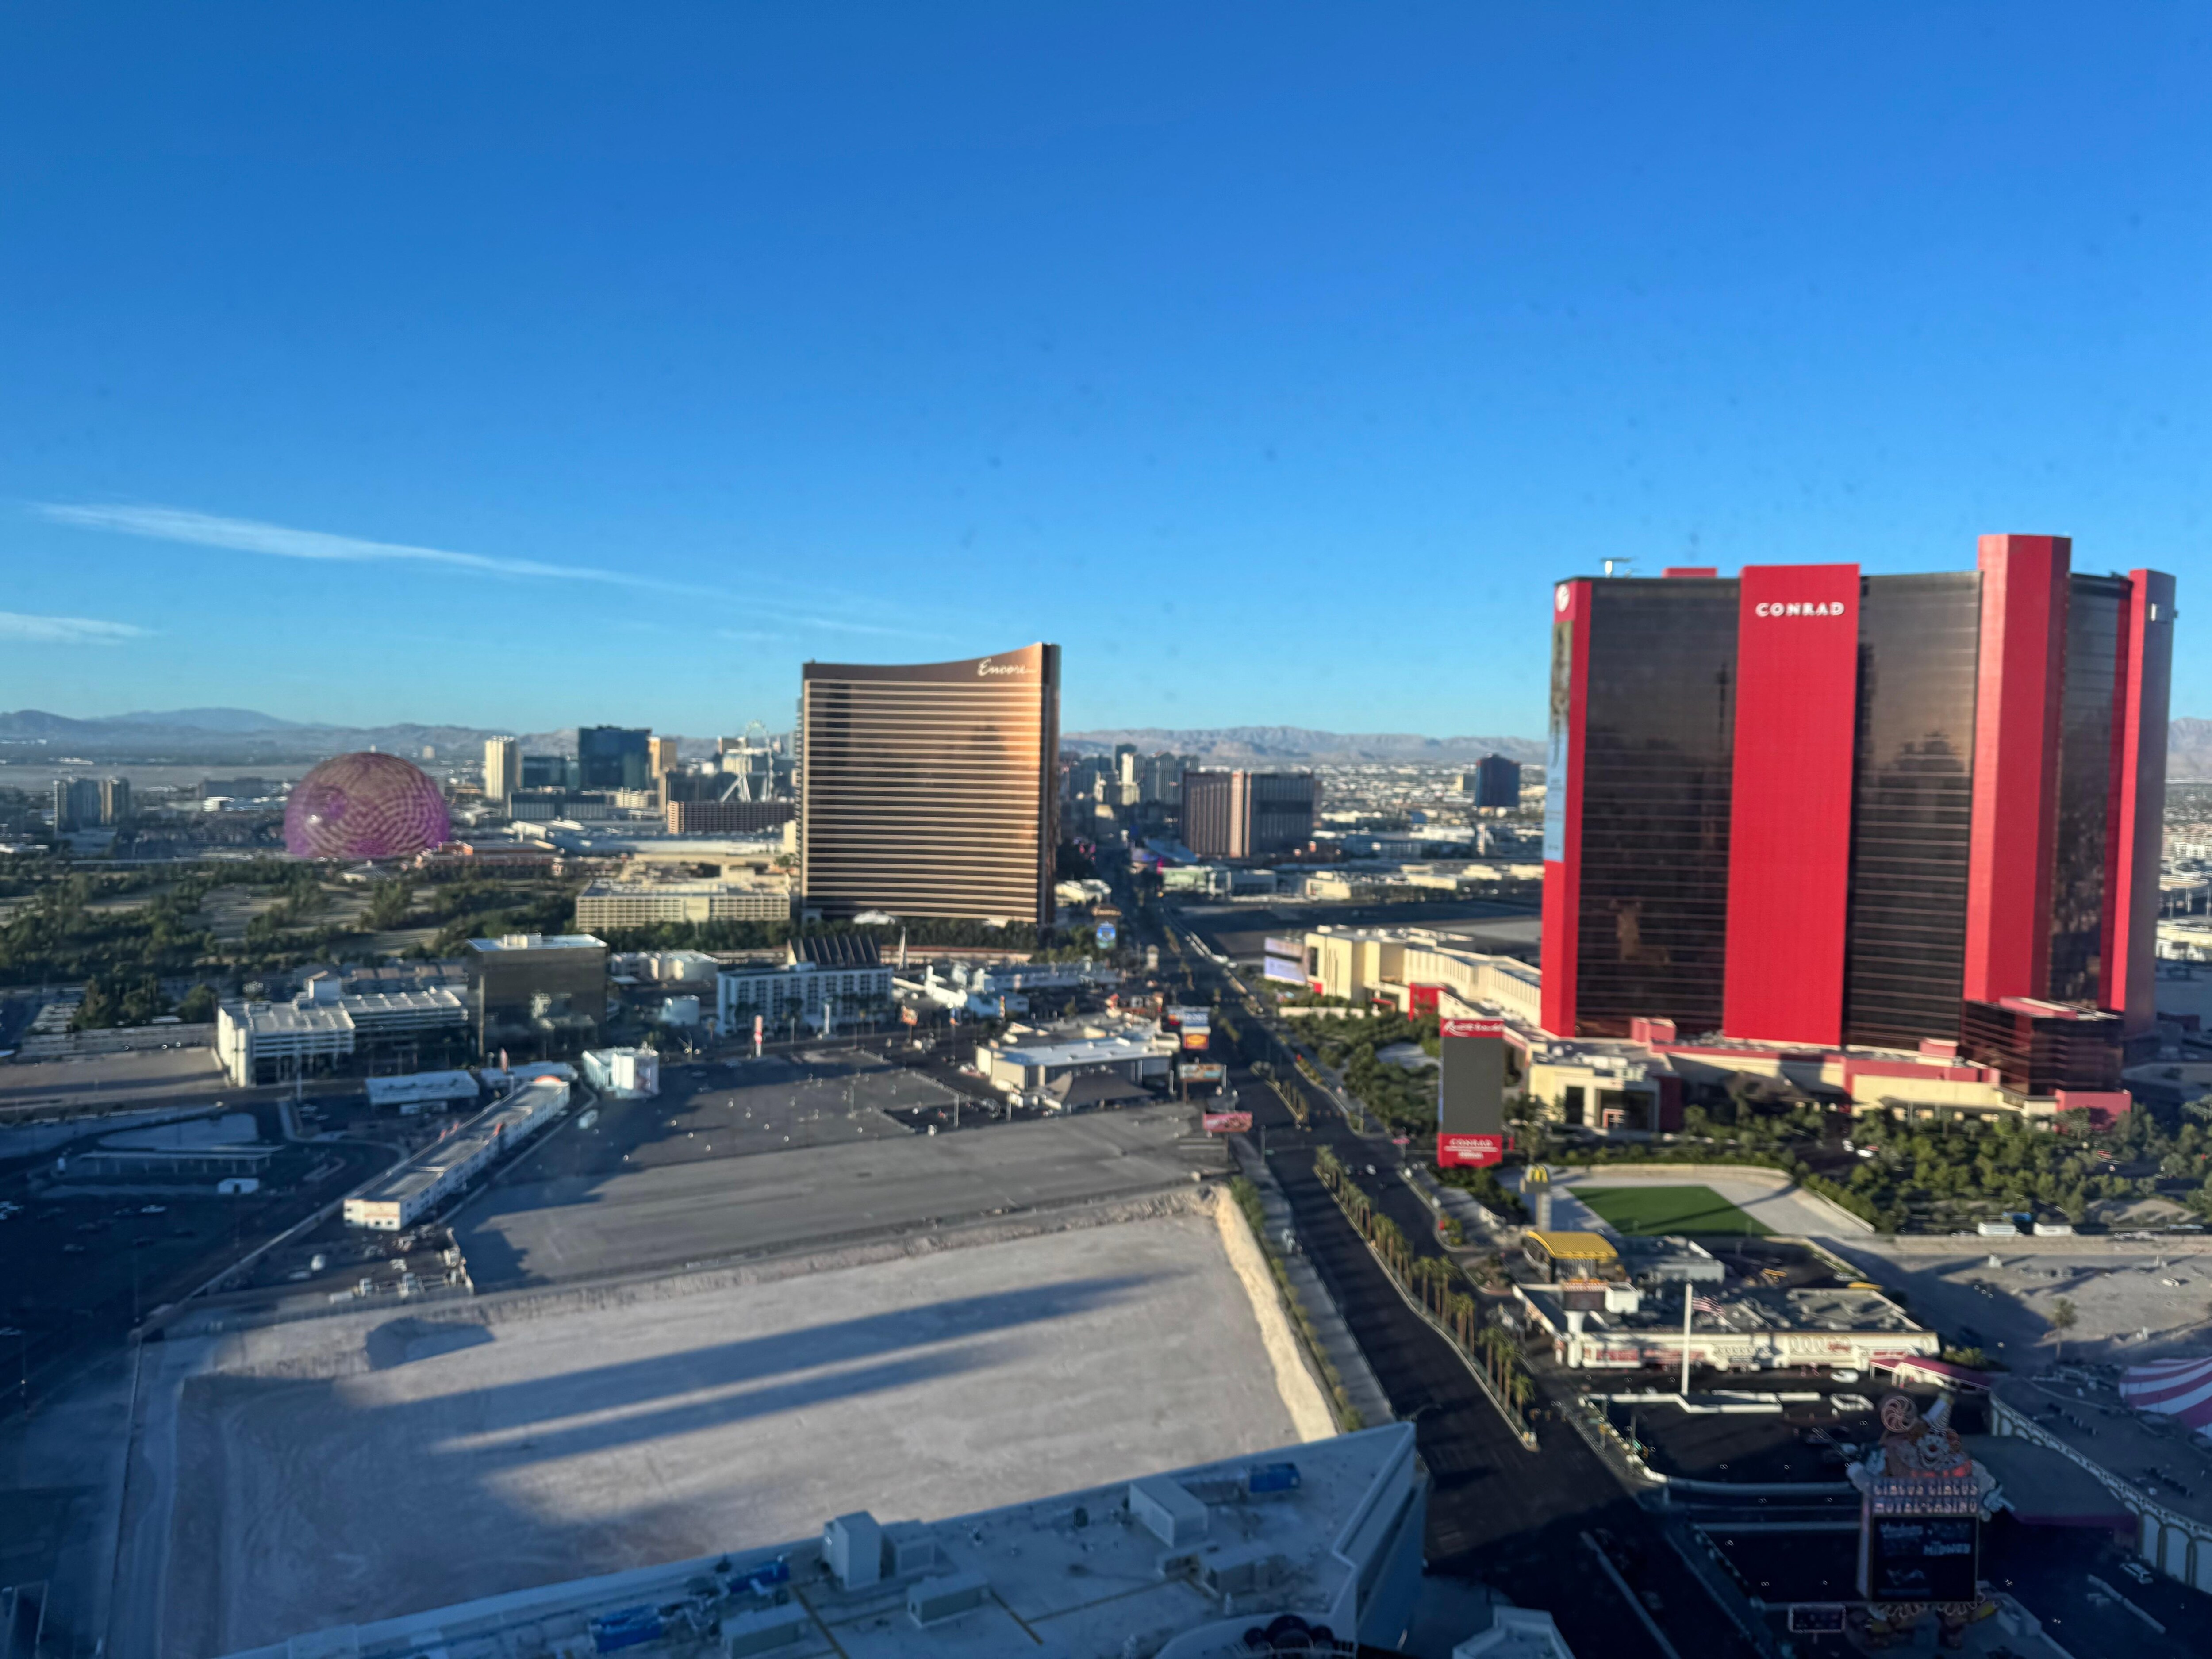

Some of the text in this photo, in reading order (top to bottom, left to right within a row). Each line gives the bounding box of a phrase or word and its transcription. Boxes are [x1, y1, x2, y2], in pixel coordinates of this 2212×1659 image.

[1755, 602, 1844, 617] CONRAD
[978, 658, 1036, 676] Encore
[1450, 1138, 1494, 1147] CONRAD
